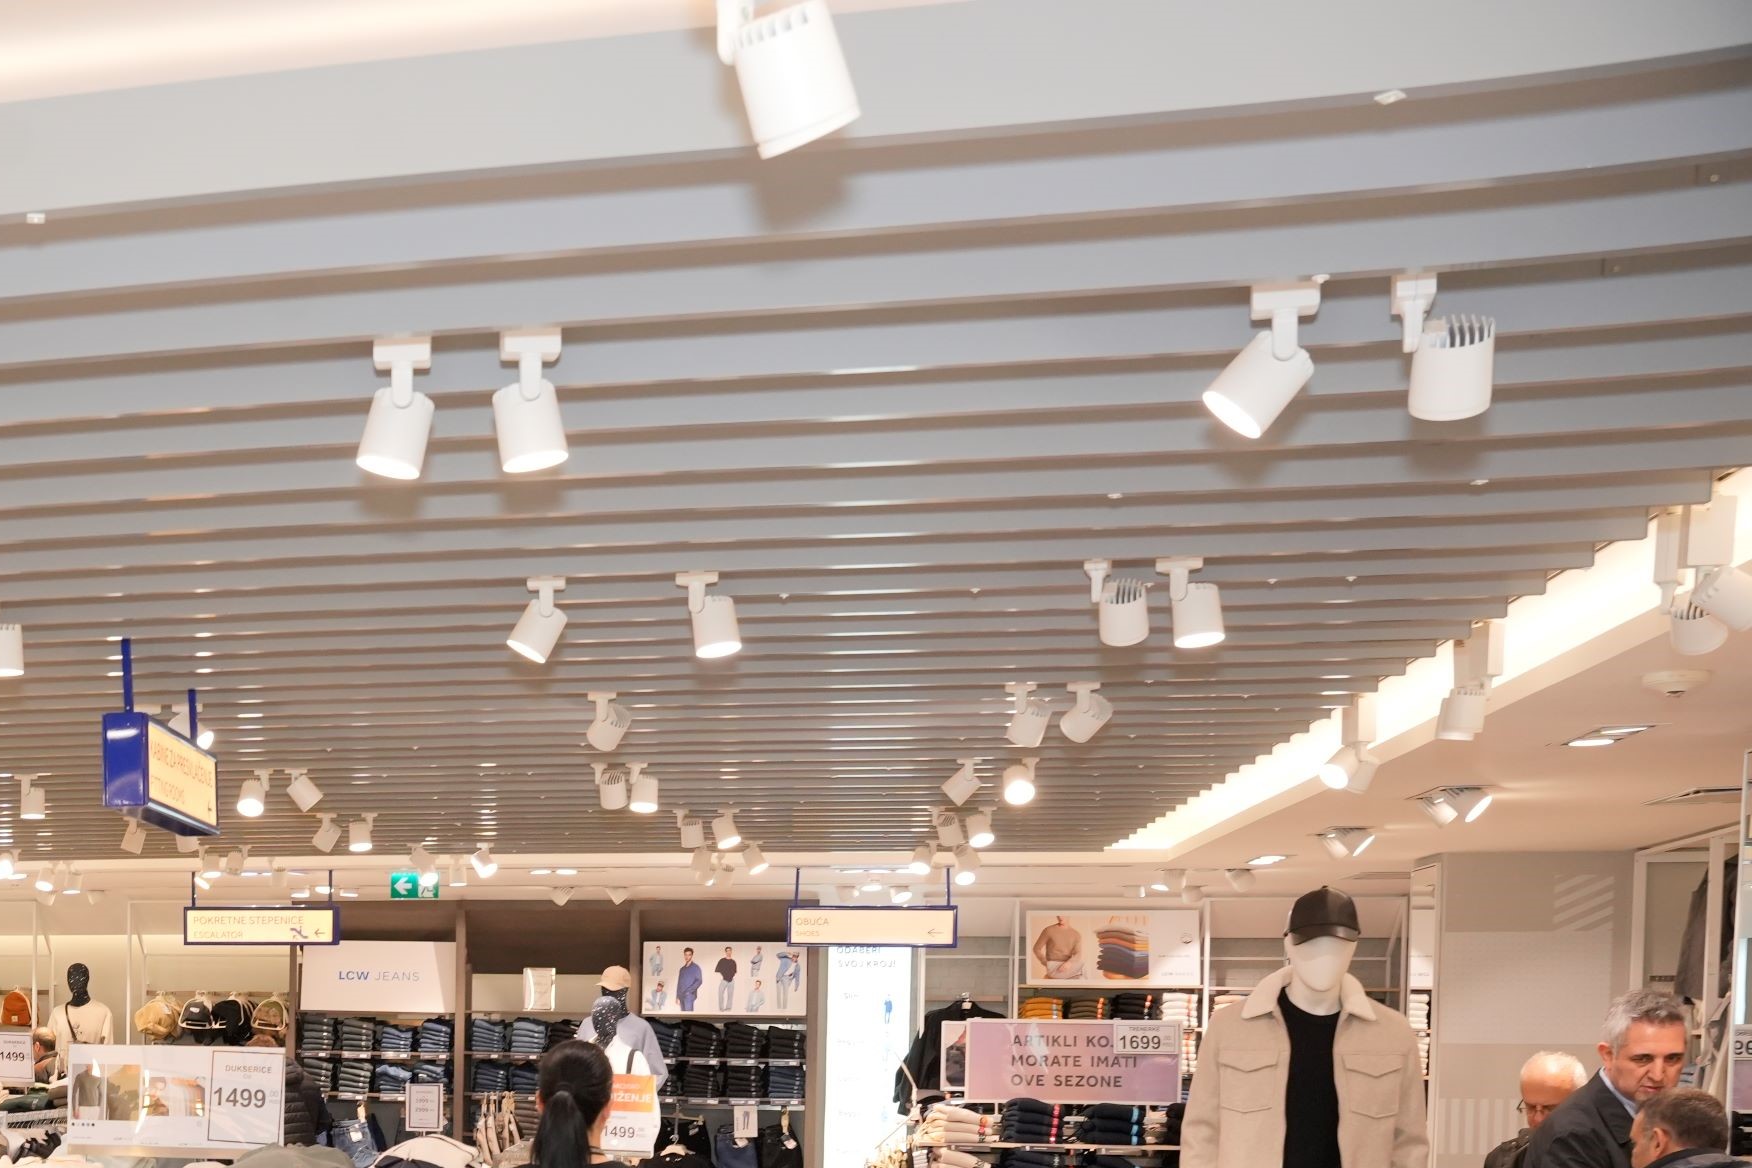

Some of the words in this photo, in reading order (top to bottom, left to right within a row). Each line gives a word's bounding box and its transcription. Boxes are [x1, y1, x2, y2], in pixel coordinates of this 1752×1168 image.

[193, 915, 247, 925] POKRETNE
[249, 915, 304, 925] STEPENICE
[193, 930, 243, 939] ESCALATOR
[338, 971, 369, 980] LCW
[375, 971, 420, 981] JEANS
[1013, 1034, 1077, 1048] ARTIKLI
[1086, 1035, 1113, 1048] KO
[1119, 1035, 1161, 1049] 1699
[0, 1051, 25, 1062] 1499
[1011, 1055, 1082, 1067] MORATE
[1090, 1056, 1137, 1068] IMATI
[225, 1064, 272, 1074] DUKSERICE
[1011, 1074, 1045, 1086] OVE
[1054, 1075, 1123, 1088] SEZONE
[214, 1087, 266, 1108] 1499
[610, 1092, 653, 1103] IŽENJE
[604, 1126, 635, 1138] 1499
